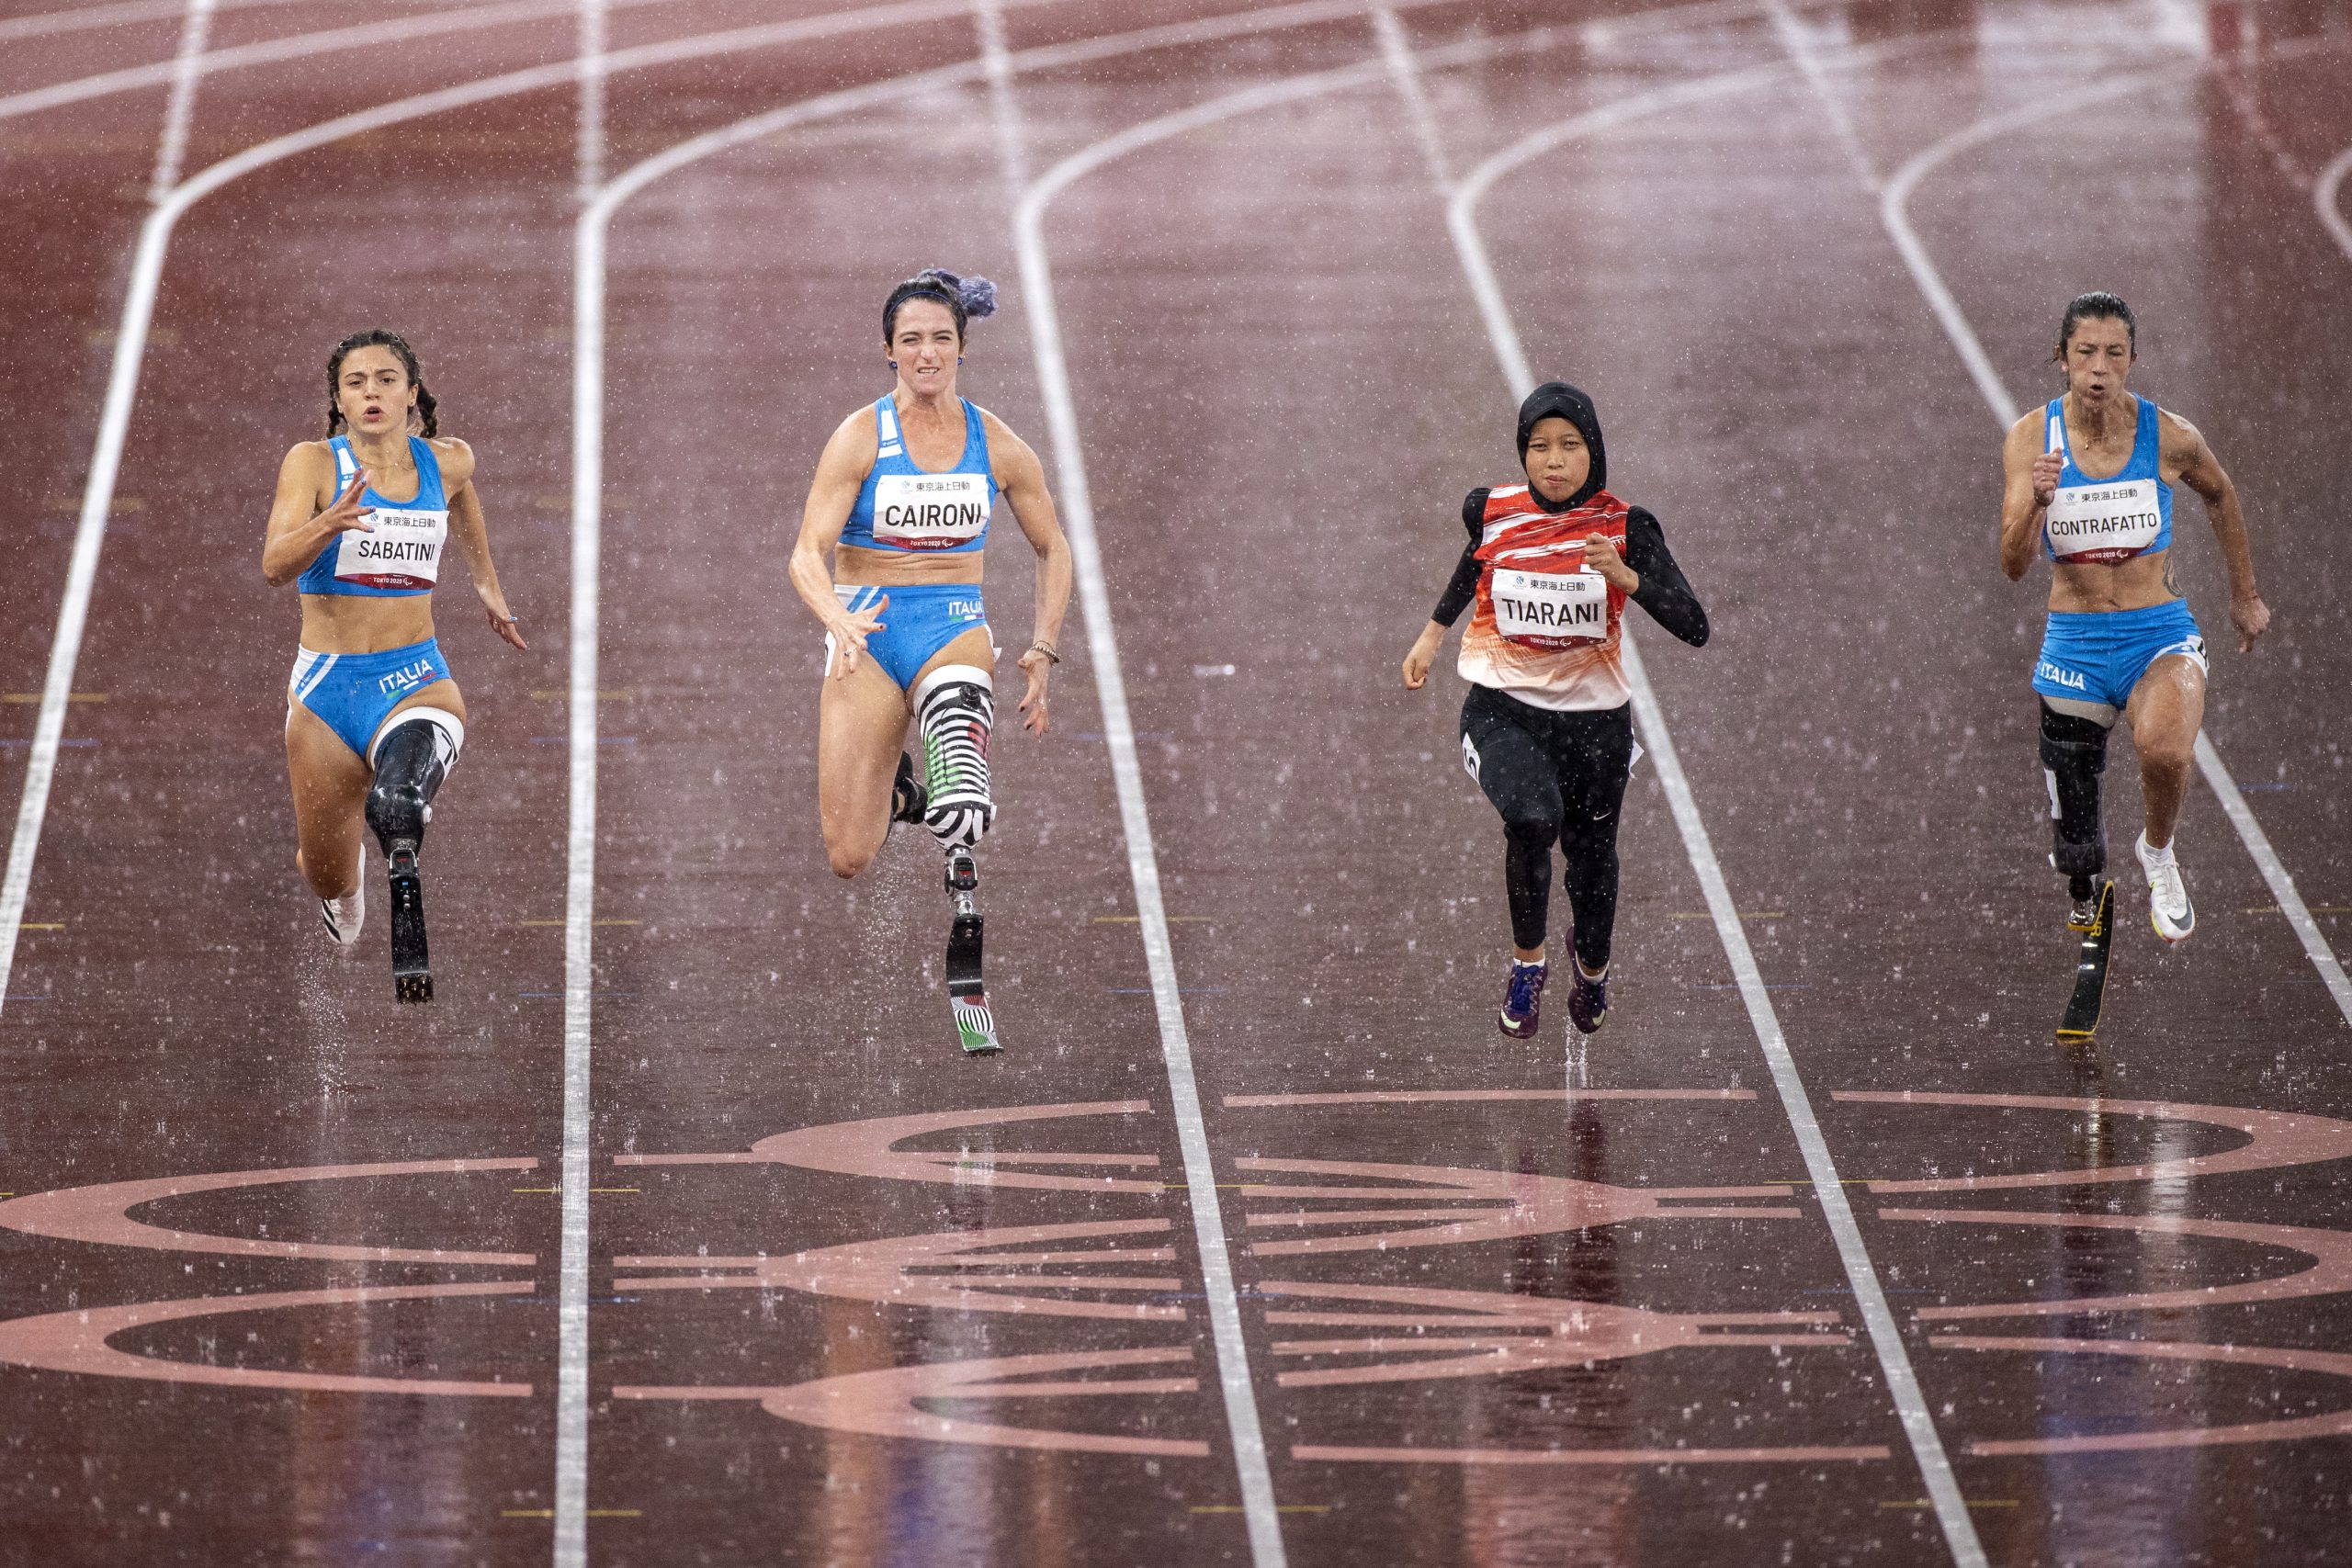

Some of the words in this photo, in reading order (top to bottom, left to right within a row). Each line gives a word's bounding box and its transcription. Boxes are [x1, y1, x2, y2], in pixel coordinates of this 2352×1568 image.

[916, 481, 970, 492] 東京海上日動
[2081, 489, 2138, 502] 東京海上日動
[383, 516, 435, 528] 東京海上日動
[885, 502, 981, 527] CAIRONI
[2052, 513, 2157, 536] CONTRAFATTO
[358, 540, 435, 561] SABATINI
[1530, 580, 1586, 592] 東京海上日動
[1501, 598, 1599, 626] TIARANI
[1530, 637, 1545, 645] TOKYO
[379, 659, 434, 694] ITALIA
[2041, 661, 2086, 691] ITALIA
